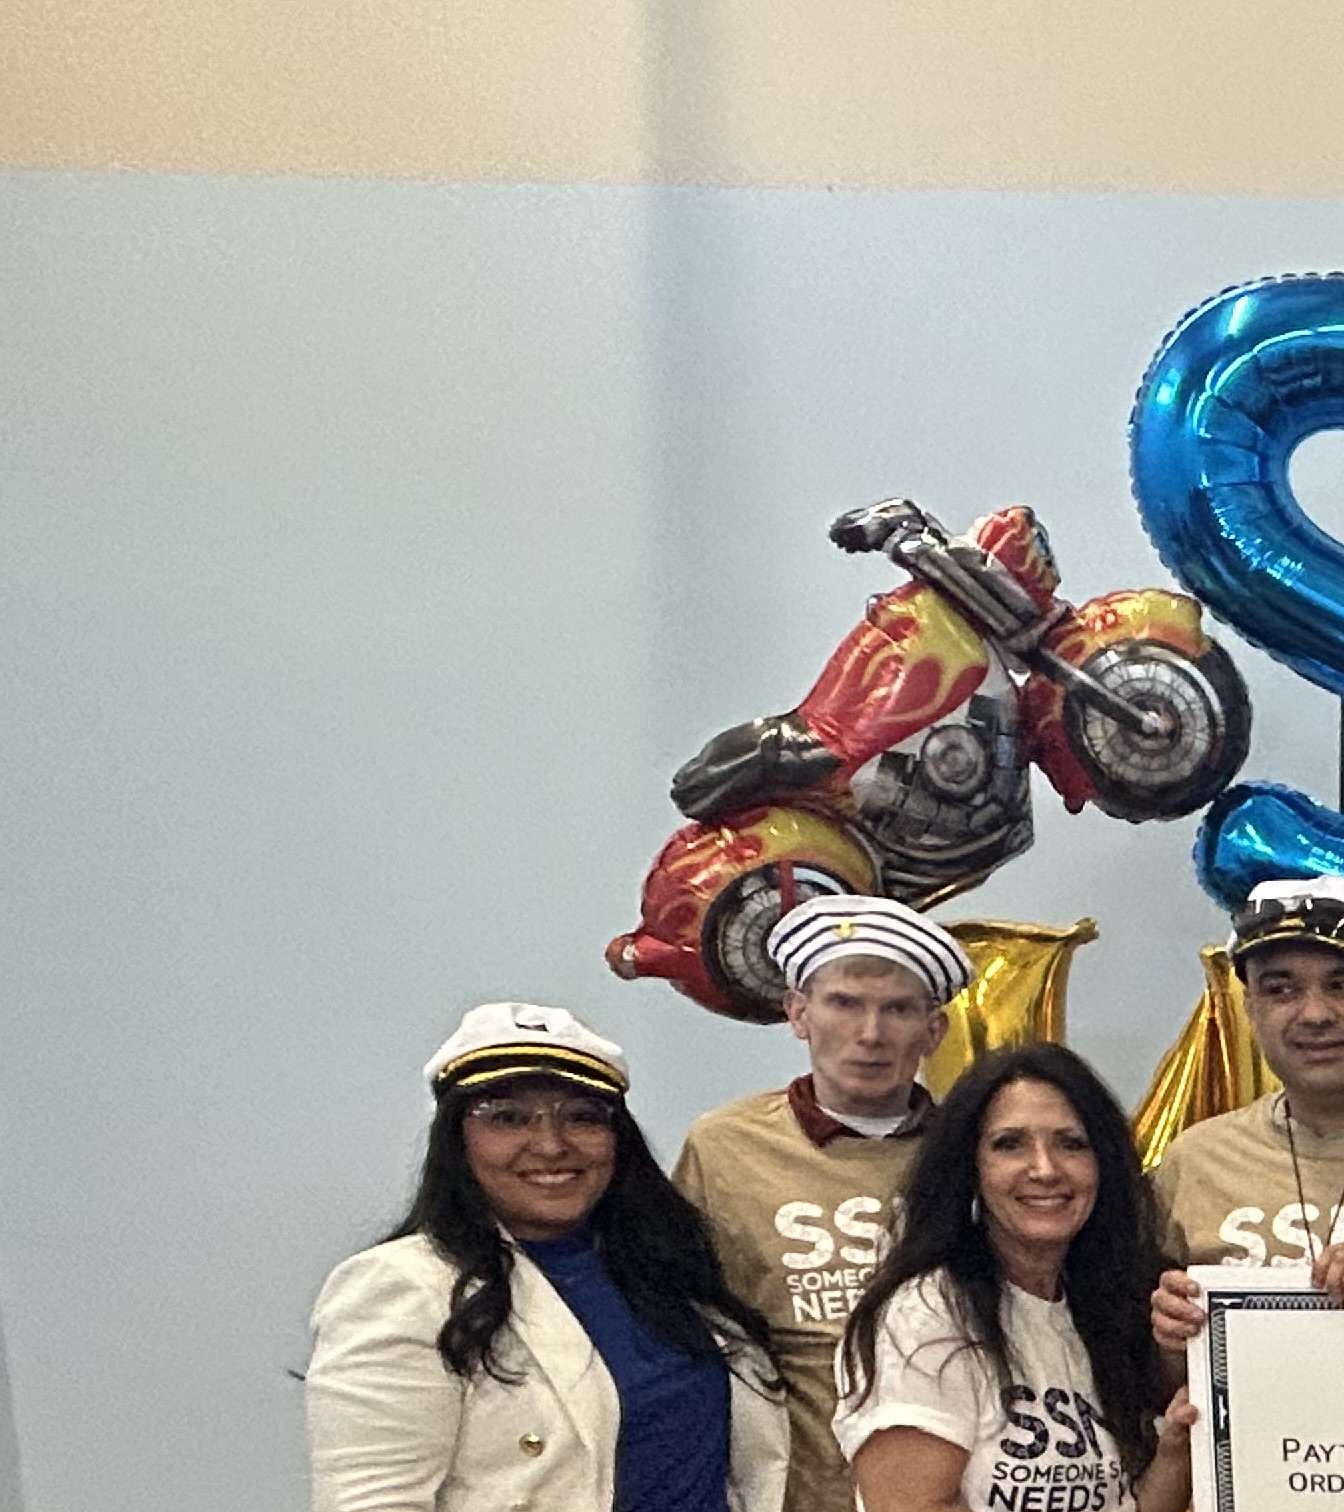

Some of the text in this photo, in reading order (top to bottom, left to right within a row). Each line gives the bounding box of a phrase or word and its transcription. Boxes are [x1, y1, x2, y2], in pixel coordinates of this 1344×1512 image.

[775, 1196, 907, 1263] SS
[786, 1266, 875, 1294] SOME
[1000, 1384, 1107, 1460] SSN
[993, 1461, 1106, 1483] SOMEONE
